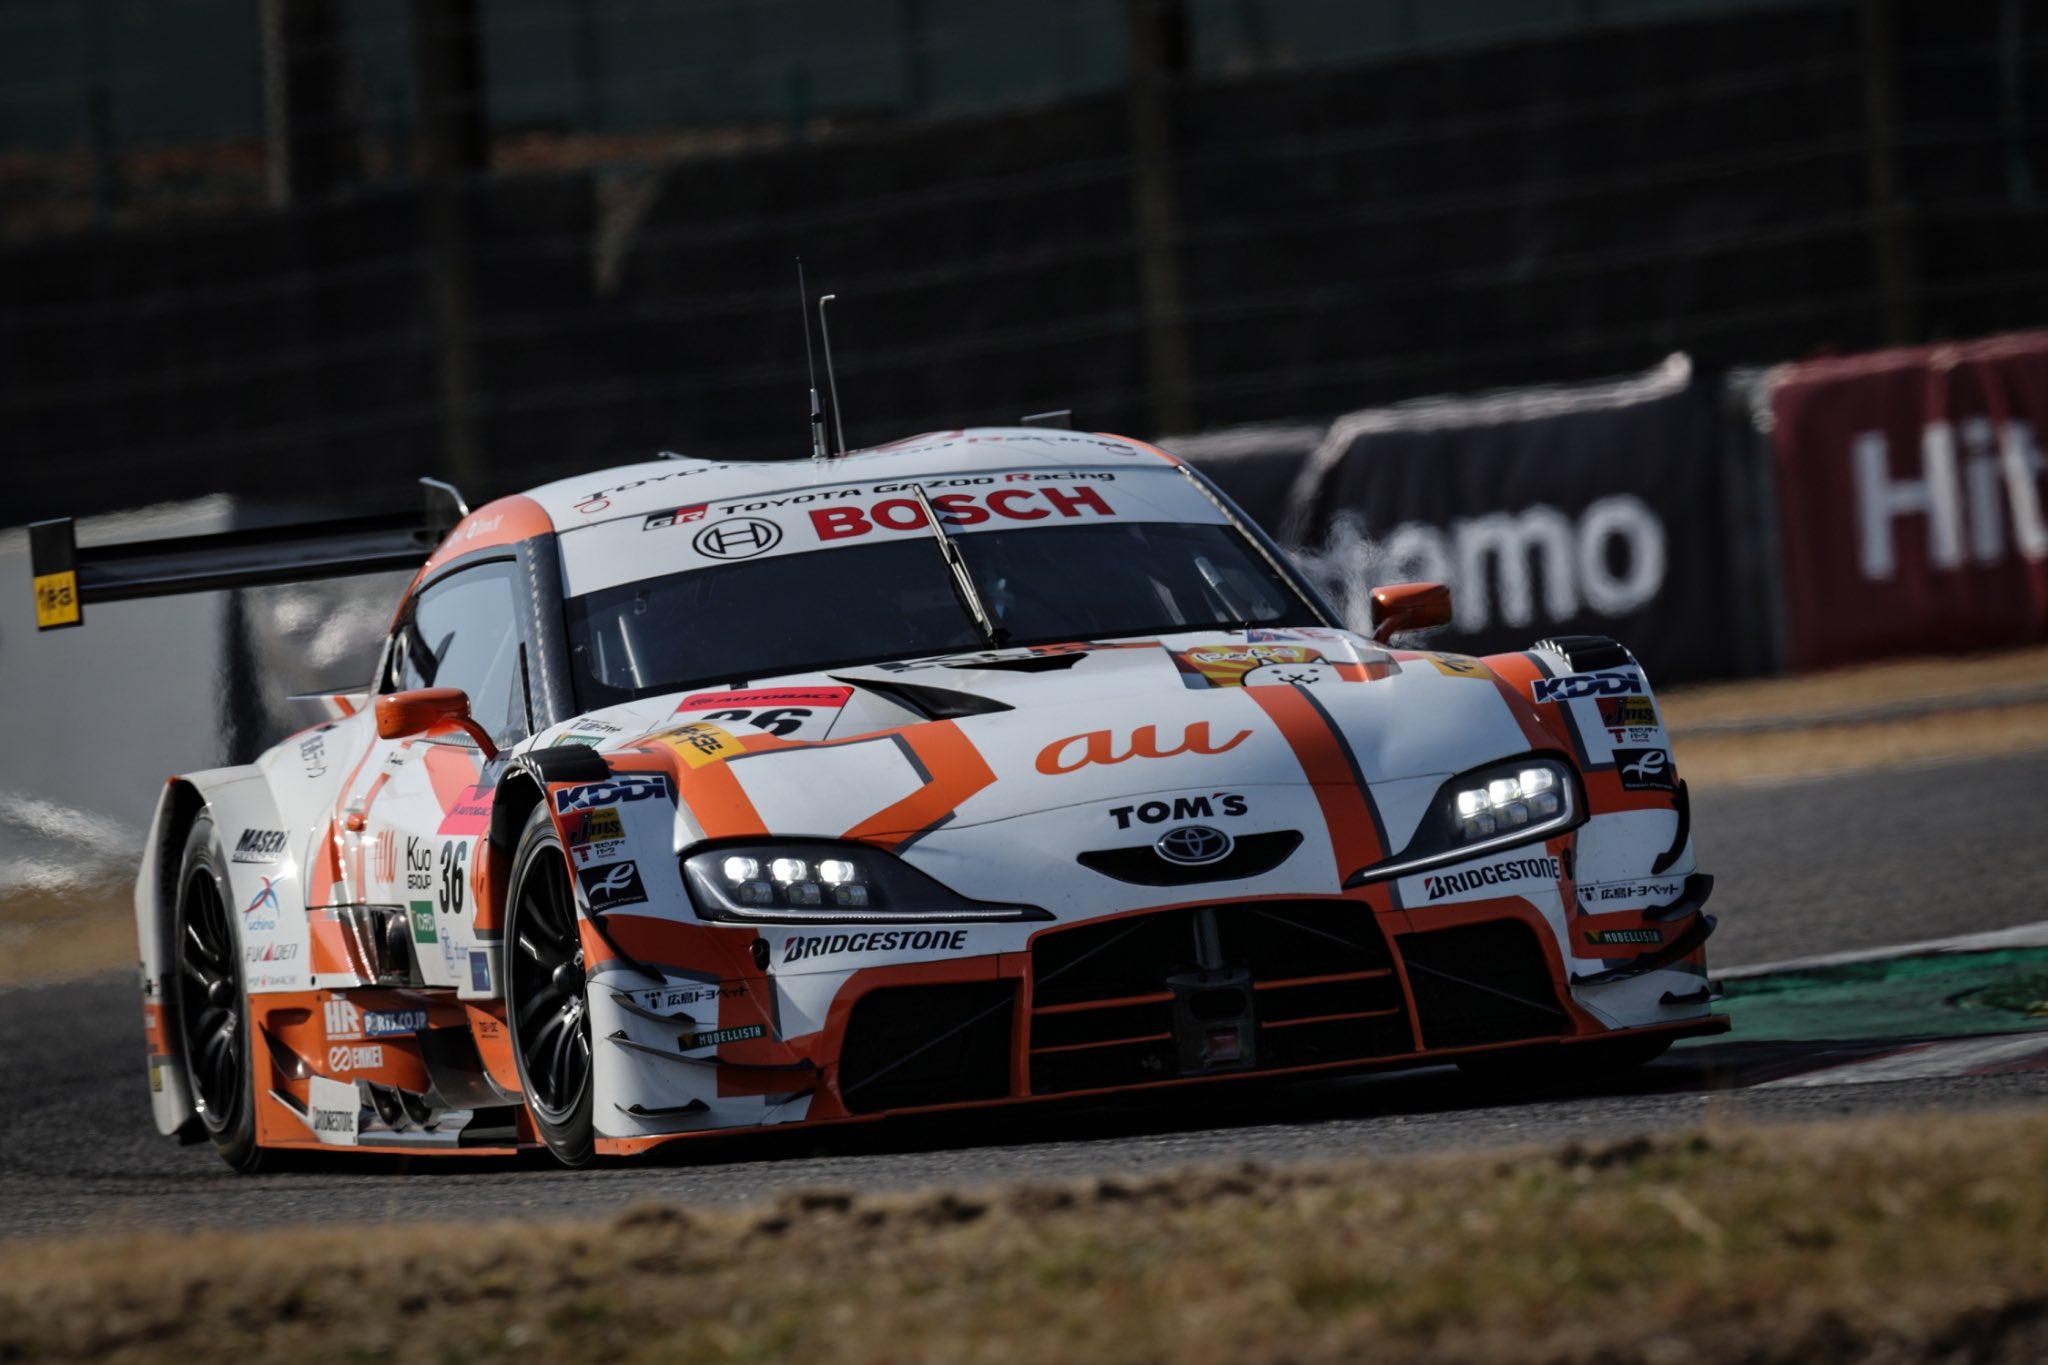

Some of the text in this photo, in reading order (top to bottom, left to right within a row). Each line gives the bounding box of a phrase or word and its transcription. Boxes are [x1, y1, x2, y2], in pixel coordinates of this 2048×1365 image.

[719, 471, 1115, 514] TOYOTA GAZOO Racing
[808, 486, 1116, 542] BOSCH
[1533, 673, 1642, 702] KDDI
[1035, 721, 1253, 775] au
[556, 777, 667, 814] KDDI
[1109, 792, 1248, 829] TOM'S
[407, 836, 431, 871] Kuo
[440, 840, 468, 914] 36
[1424, 858, 1561, 900] BRIDGESTONE
[782, 930, 968, 963] BRIDGESTONE
[1603, 931, 1660, 943] MODELLISTA
[699, 1026, 762, 1047] MODELLISTA
